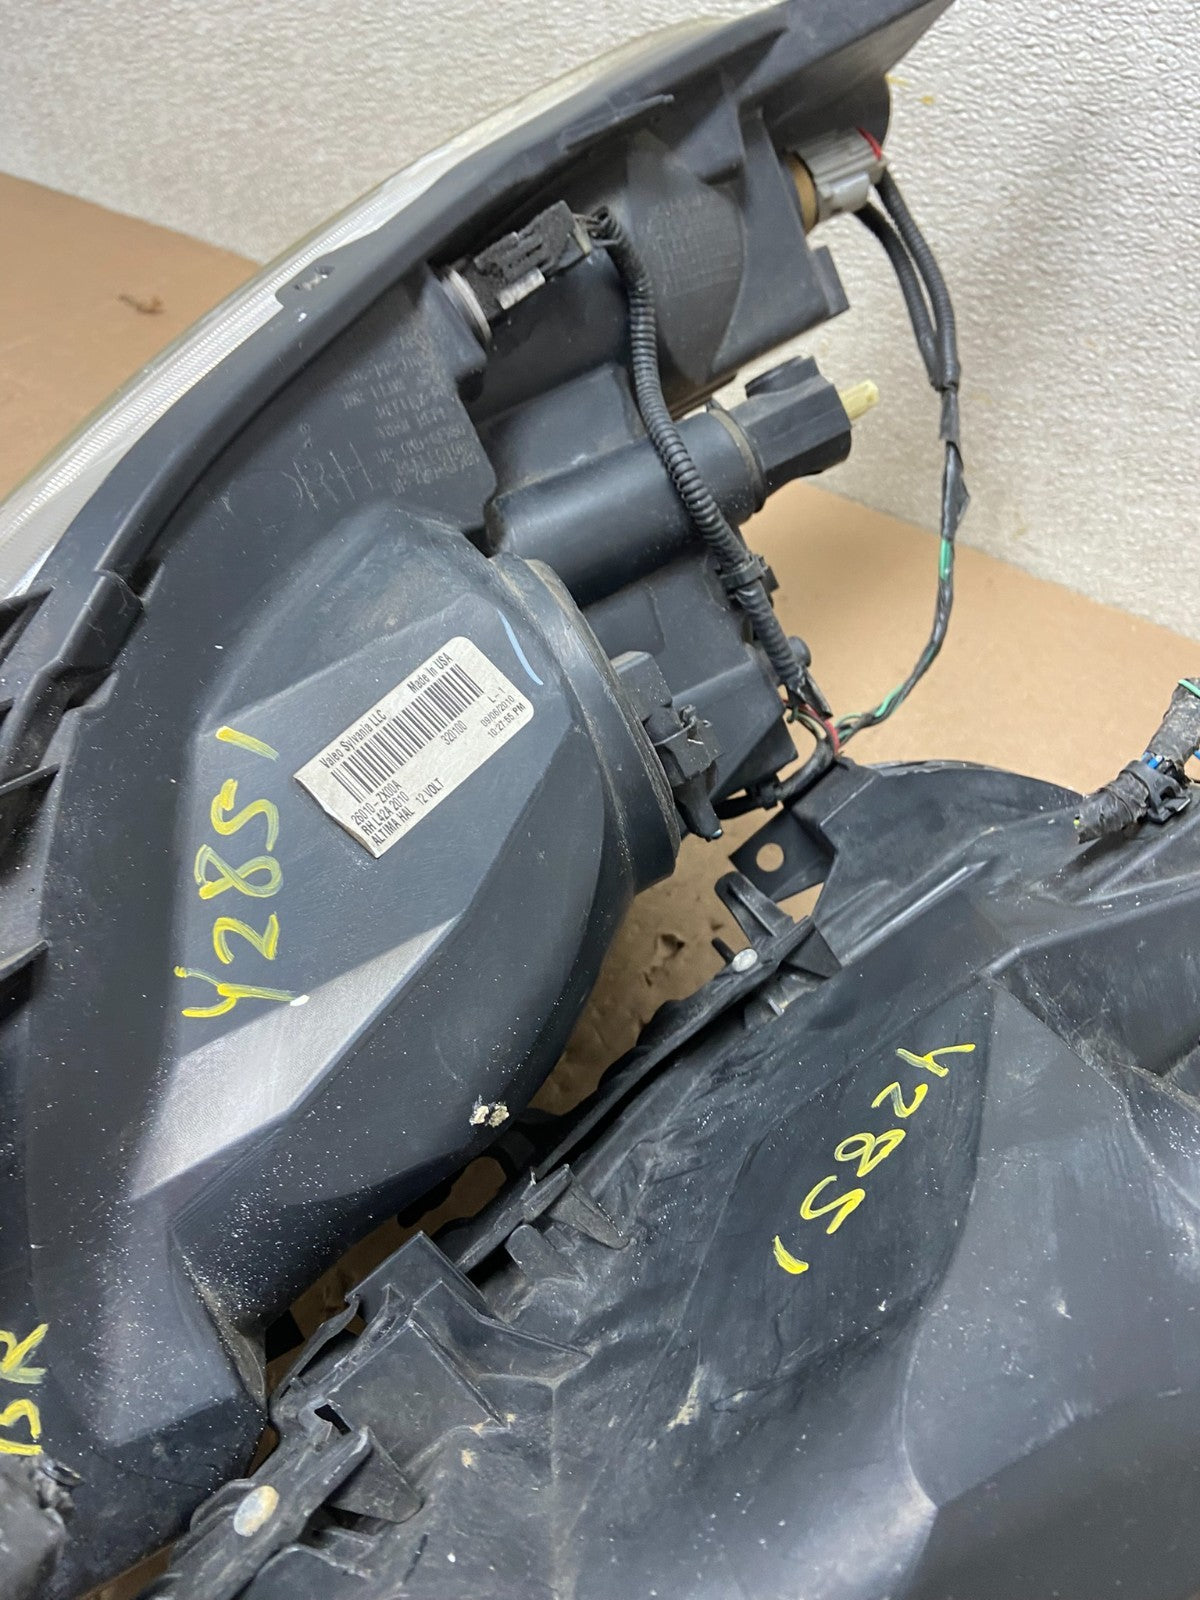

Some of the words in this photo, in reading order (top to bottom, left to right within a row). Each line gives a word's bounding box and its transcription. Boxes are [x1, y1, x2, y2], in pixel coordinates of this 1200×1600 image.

[319, 748, 344, 769] Valeo
[340, 723, 373, 752] Sylvania
[368, 709, 387, 727] LLC
[406, 673, 430, 694] Made
[425, 665, 438, 679] In
[433, 652, 453, 670] USA
[361, 819, 377, 836] RH
[371, 806, 394, 826] L42A
[388, 790, 410, 811] 2010
[480, 694, 515, 727] 09/06/2010
[371, 818, 402, 846] ALTIMA
[396, 806, 415, 823] HAL
[415, 792, 428, 806] 12
[422, 777, 444, 798] VOLT
[512, 702, 526, 716] PM
[440, 720, 468, 745] 320100
